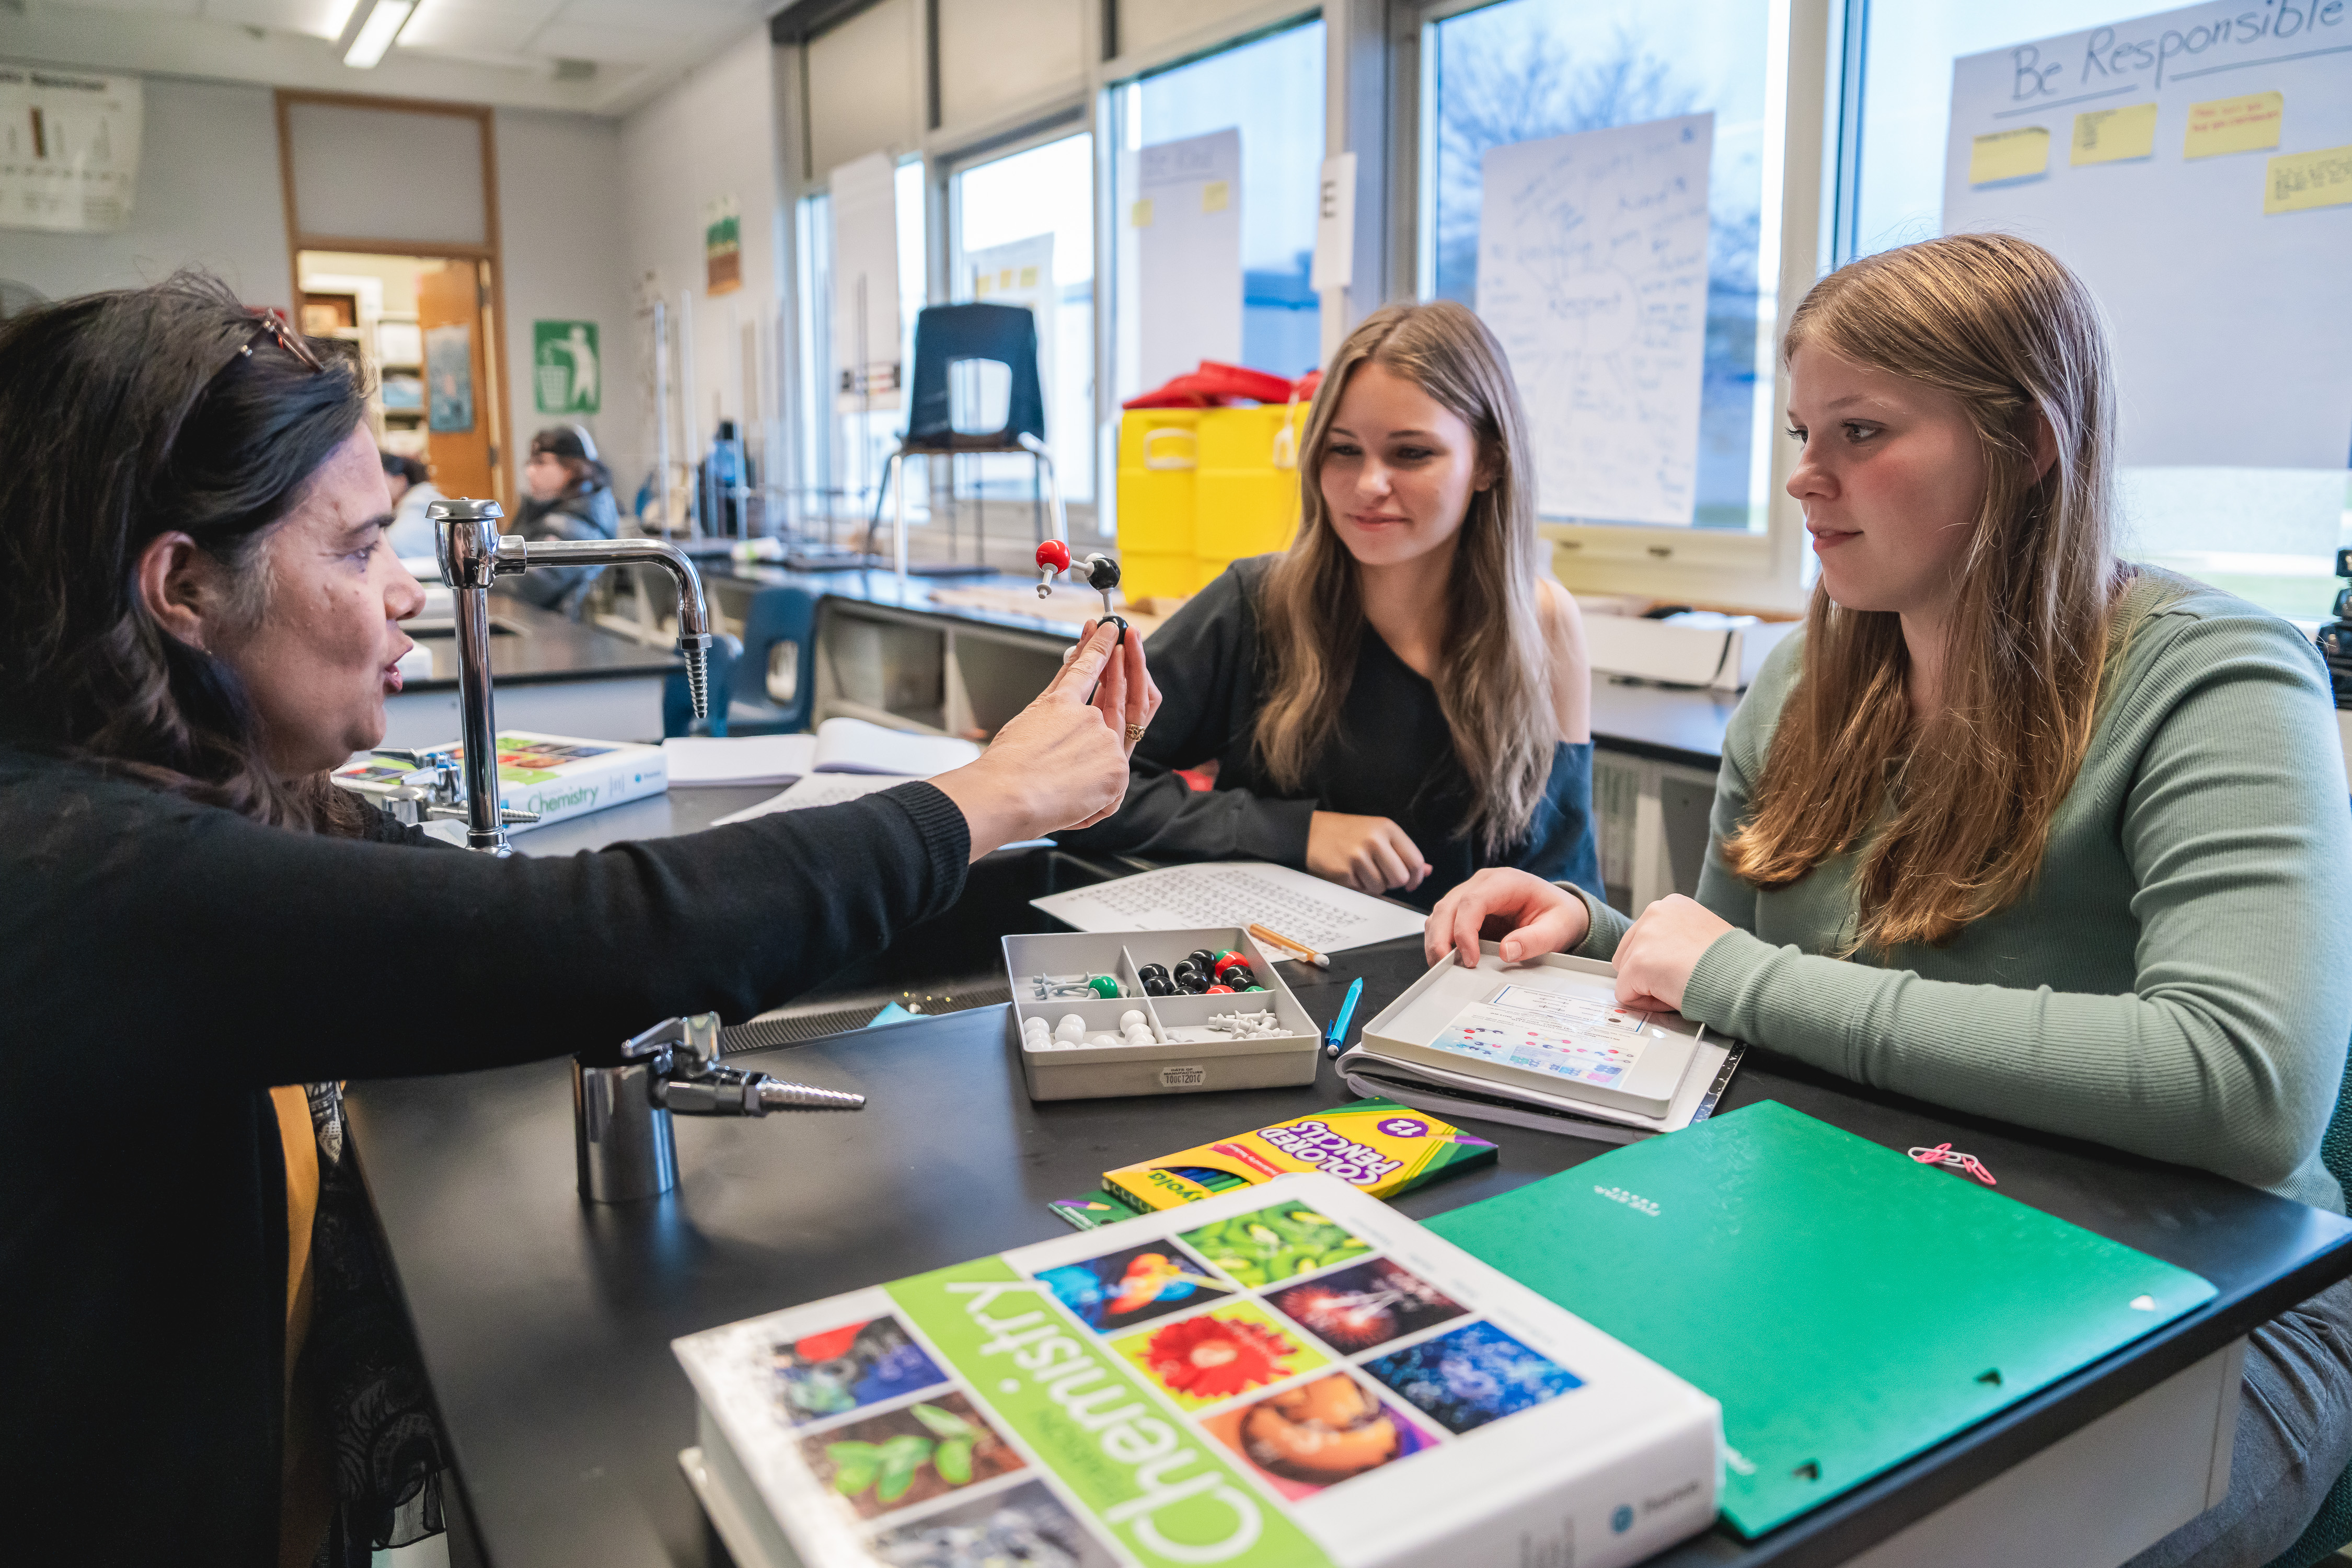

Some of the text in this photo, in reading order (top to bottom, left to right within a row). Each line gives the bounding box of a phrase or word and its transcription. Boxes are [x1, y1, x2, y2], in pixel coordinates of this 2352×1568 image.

[2010, 0, 2345, 100] Be Responsible
[527, 786, 599, 813] Chemistry
[1289, 1121, 1402, 1175] PENCILS
[1387, 1120, 1422, 1136] 12
[1260, 1128, 1379, 1185] COLORED
[944, 1280, 1263, 1564] Chemistry
